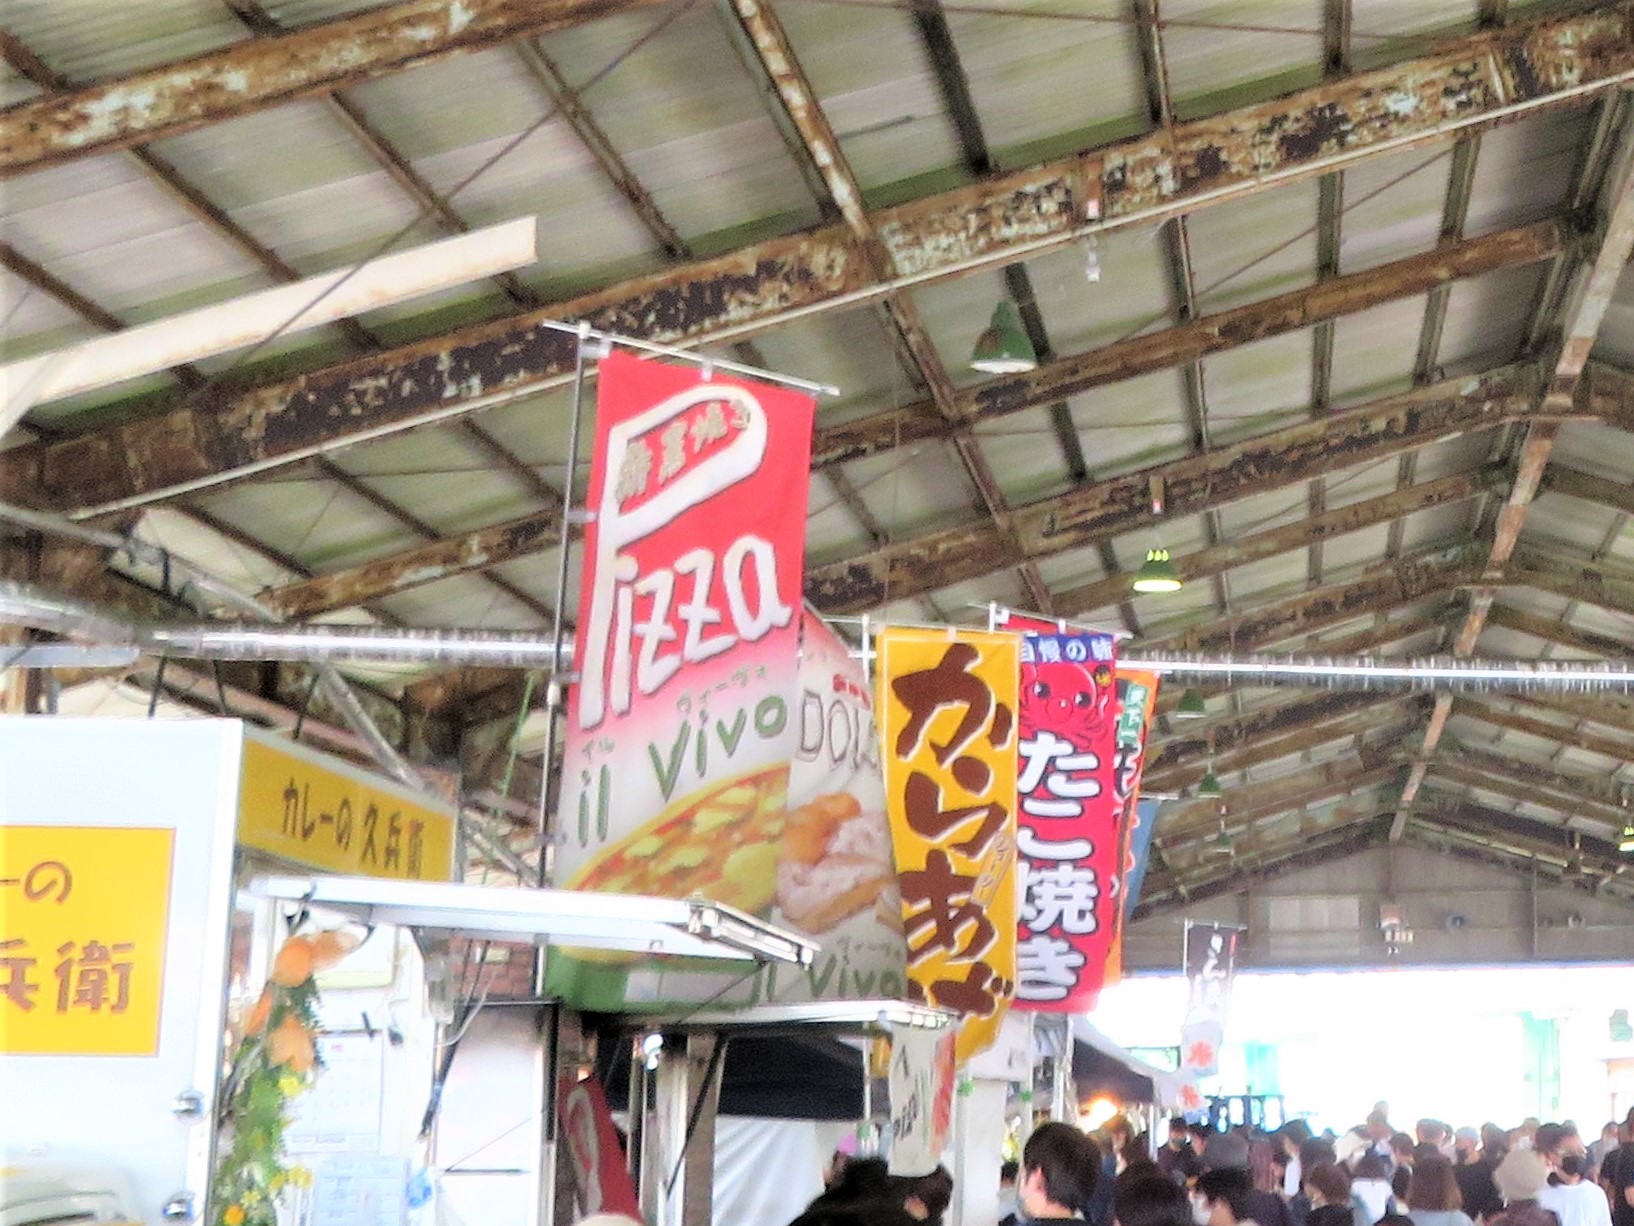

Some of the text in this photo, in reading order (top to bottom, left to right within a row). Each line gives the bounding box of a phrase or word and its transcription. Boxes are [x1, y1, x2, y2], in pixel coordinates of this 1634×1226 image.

[578, 384, 792, 730] Pizza
[1016, 730, 1101, 1003] たこ焼き
